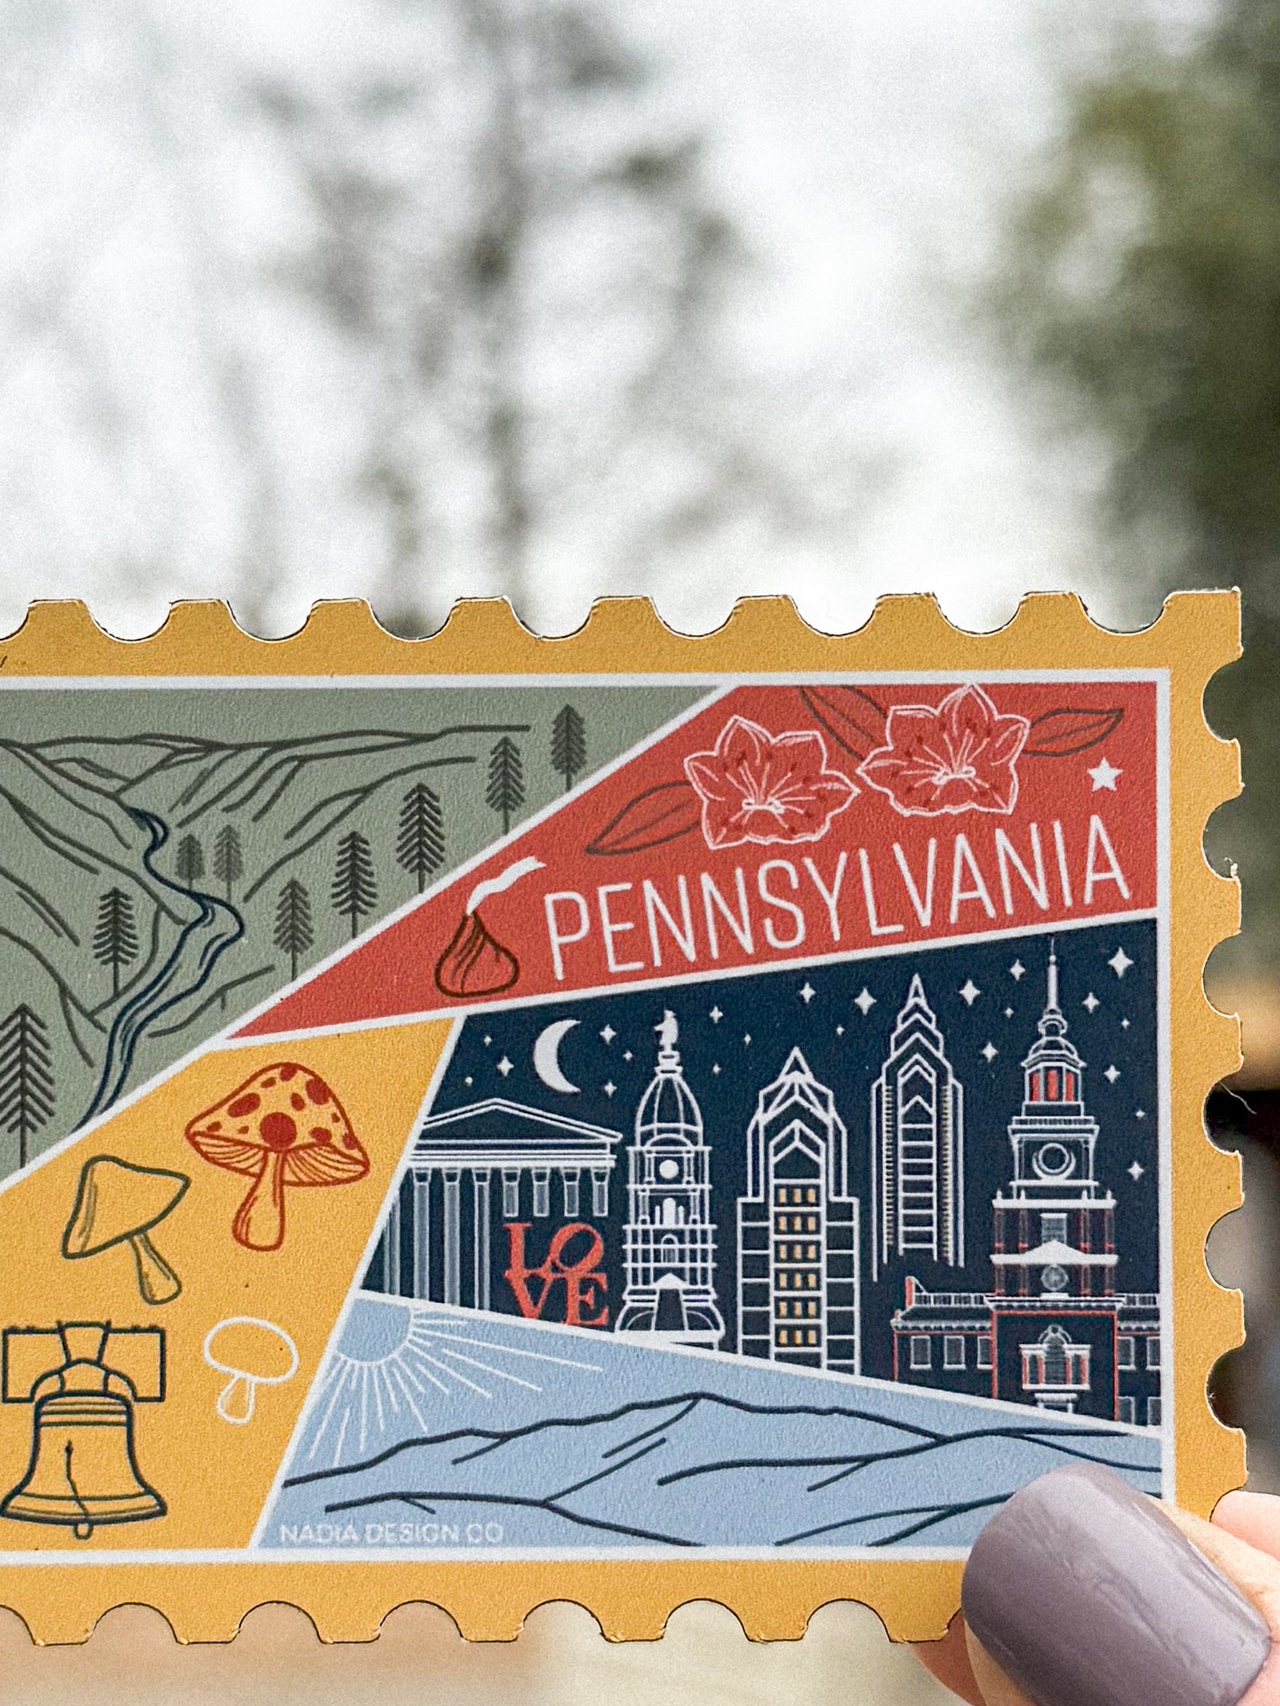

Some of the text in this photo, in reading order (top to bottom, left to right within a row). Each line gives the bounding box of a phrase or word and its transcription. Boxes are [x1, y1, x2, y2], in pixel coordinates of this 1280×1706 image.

[544, 814, 1131, 981] PENNSYLVANIA
[279, 1522, 504, 1543] NADIA DESIGN CO
